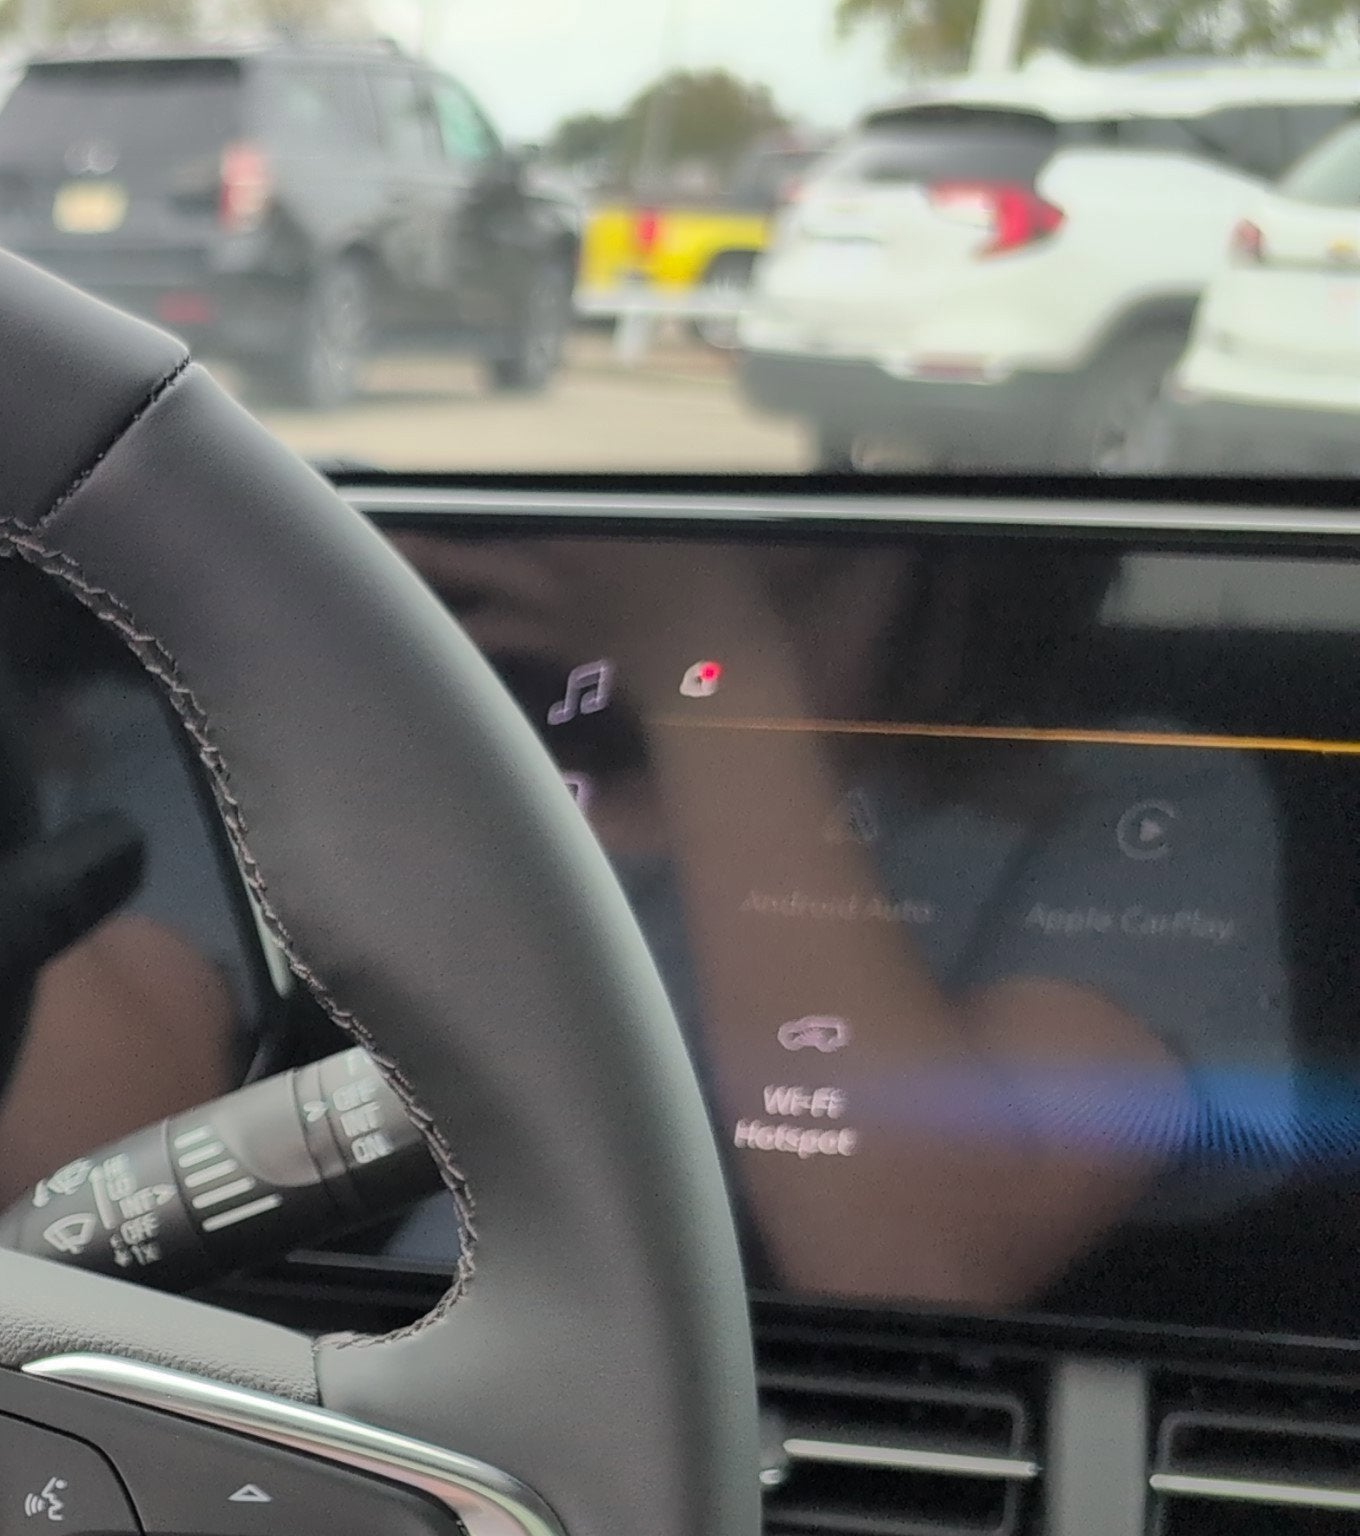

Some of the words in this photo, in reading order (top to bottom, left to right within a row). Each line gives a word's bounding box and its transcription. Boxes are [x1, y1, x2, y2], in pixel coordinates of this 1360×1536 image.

[1026, 902, 1114, 935] Apple
[764, 1084, 848, 1119] Wi-Fi
[734, 1120, 857, 1159] Hotspot
